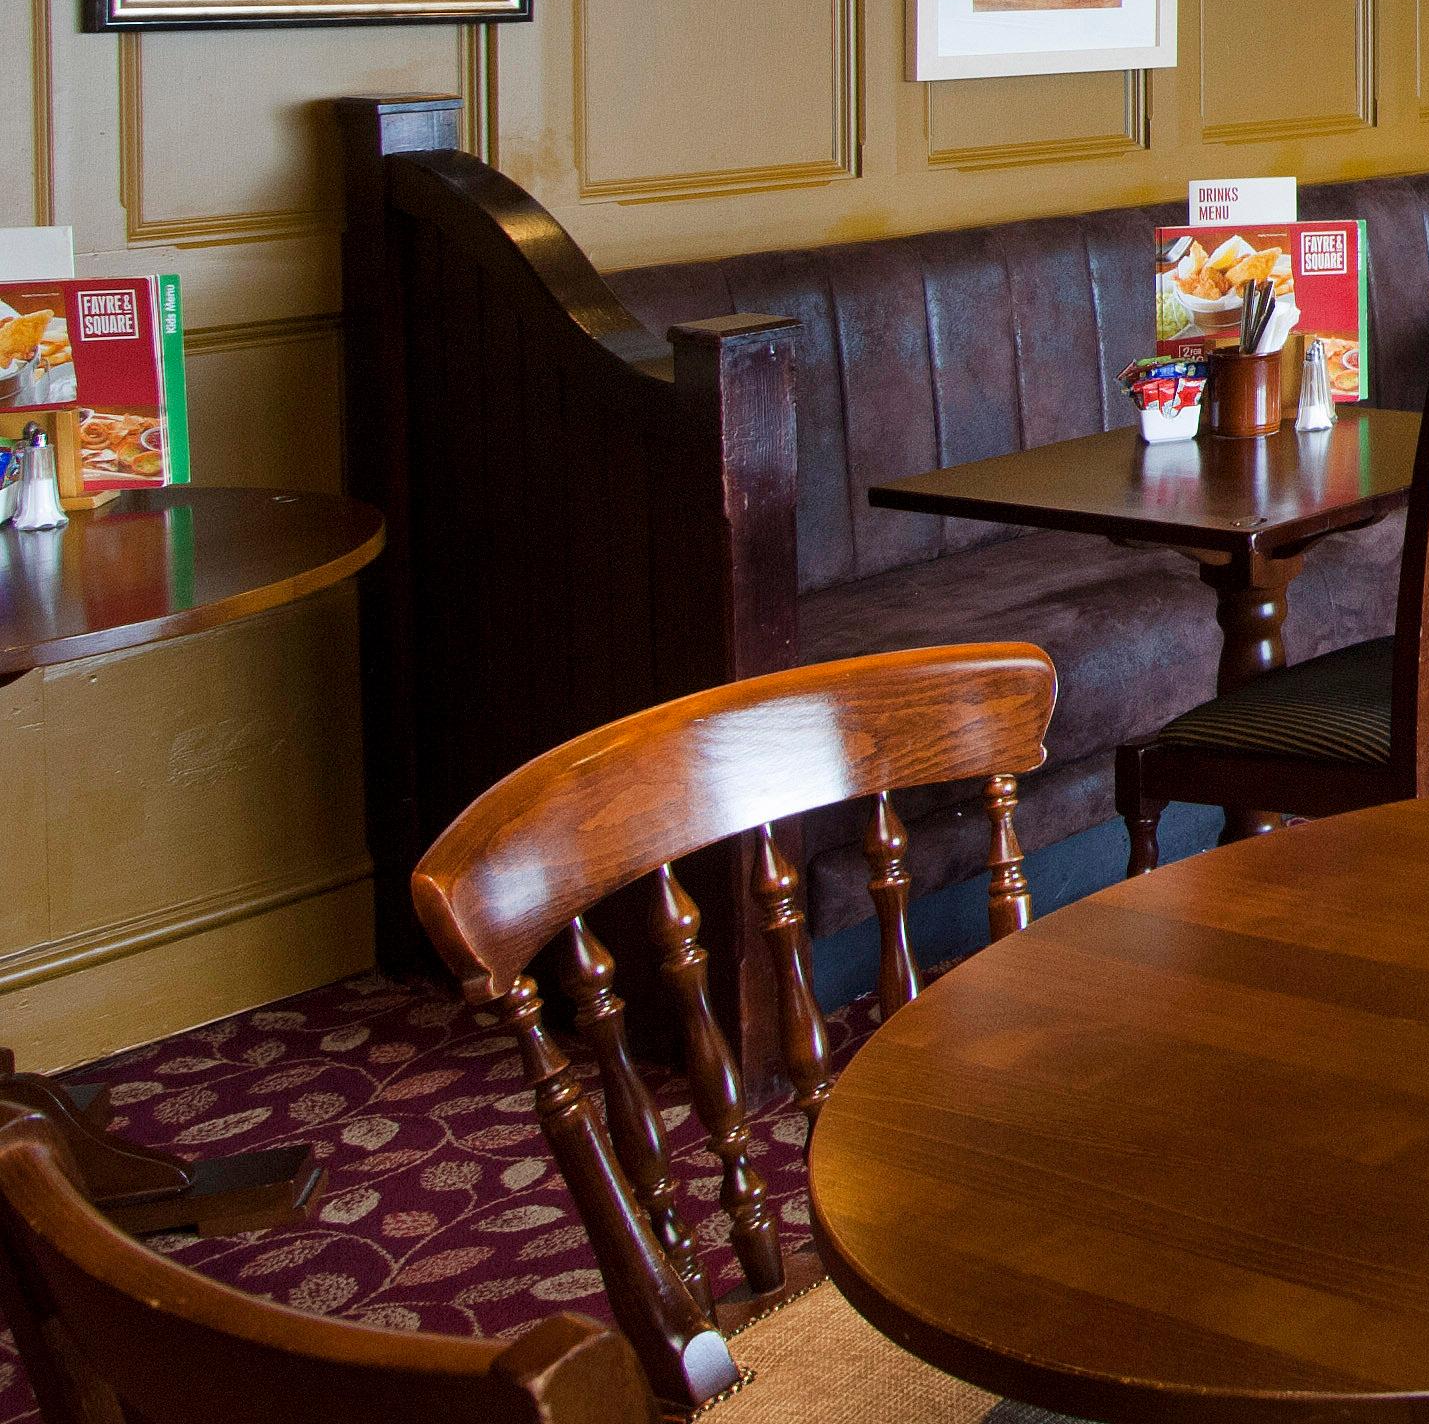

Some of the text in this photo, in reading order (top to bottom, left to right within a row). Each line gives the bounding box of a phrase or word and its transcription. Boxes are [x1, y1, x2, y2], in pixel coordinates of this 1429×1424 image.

[1199, 187, 1239, 203] DRINKS
[1199, 205, 1230, 220] MENU
[1305, 235, 1335, 253] FAYRE
[1336, 235, 1343, 252] &
[1305, 253, 1343, 270] SQUARE
[84, 295, 132, 315] FAYRE &
[85, 314, 133, 335] SQUARE
